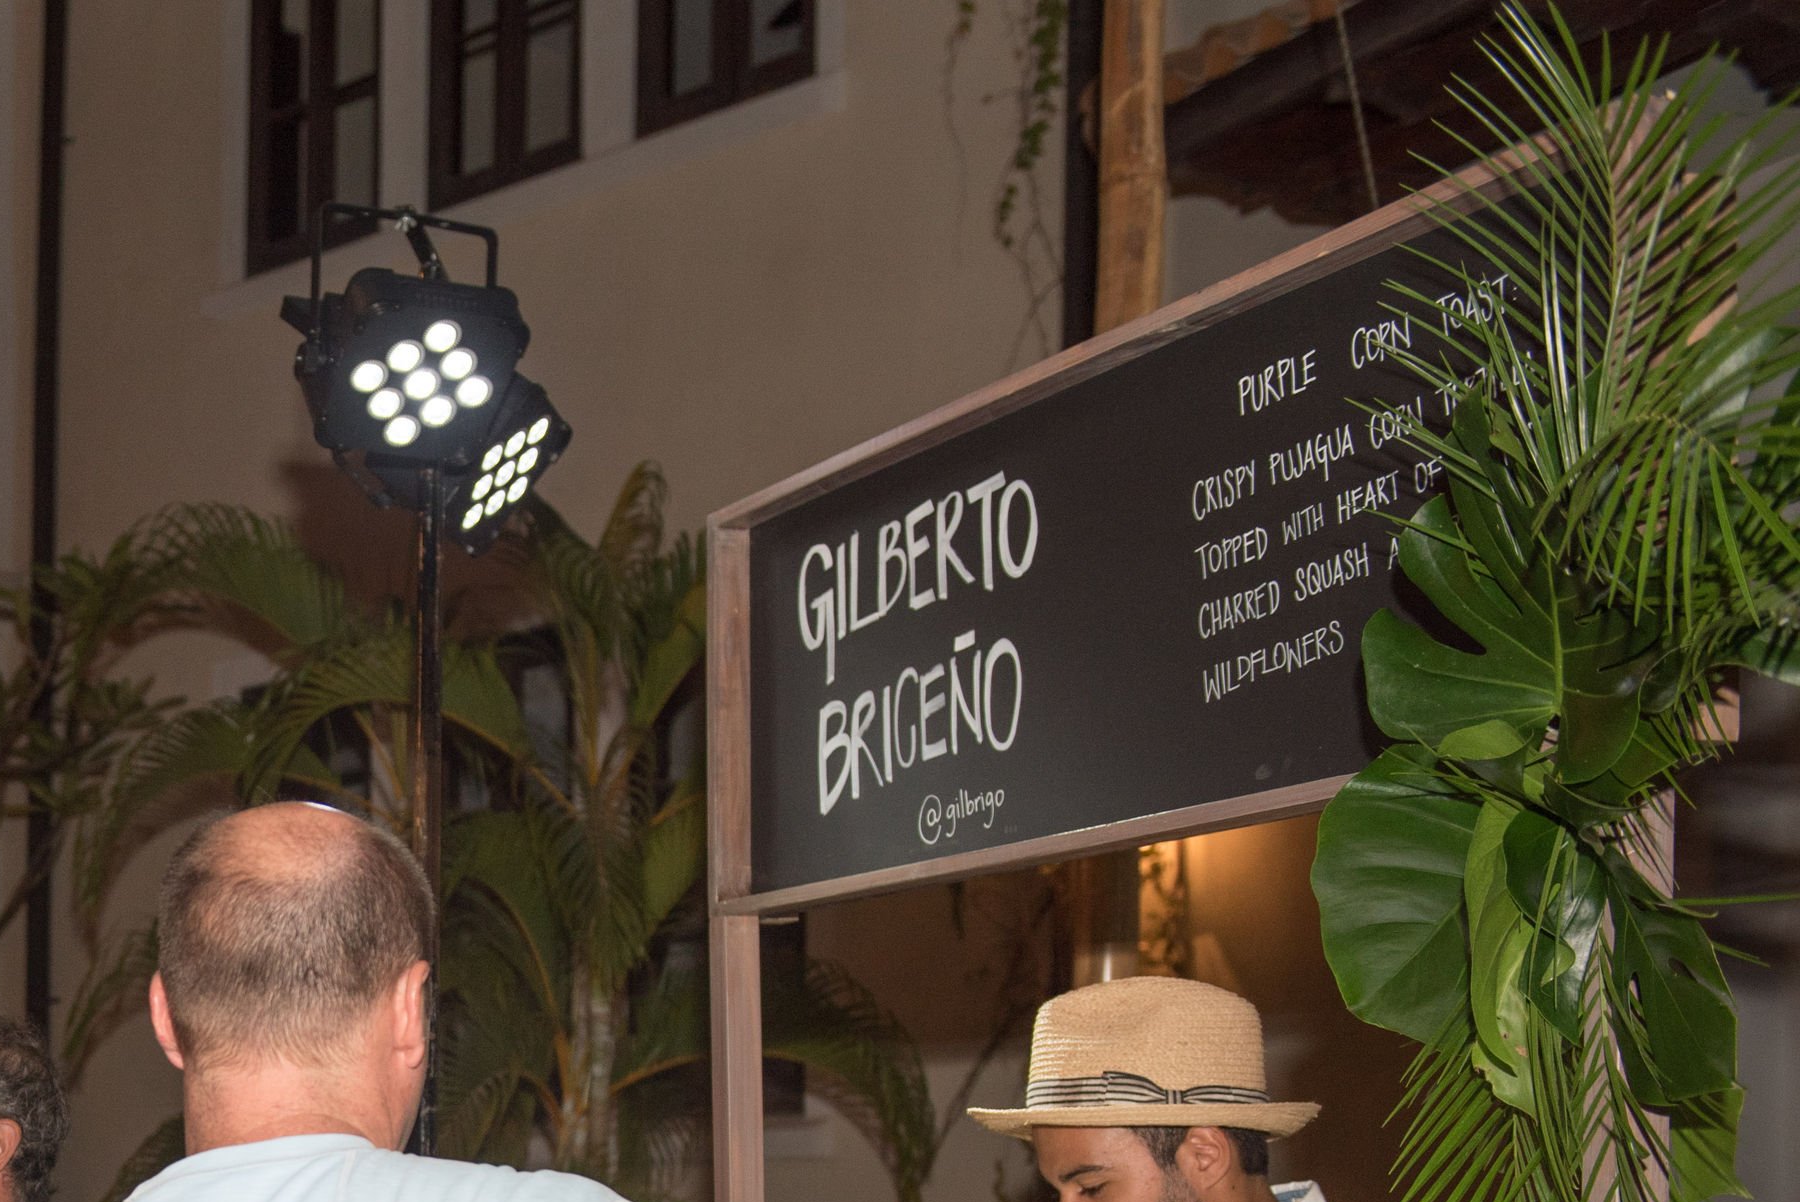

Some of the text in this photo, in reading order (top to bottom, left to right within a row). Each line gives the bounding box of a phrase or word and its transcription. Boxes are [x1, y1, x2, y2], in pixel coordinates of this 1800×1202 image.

[1238, 349, 1317, 416] PURPLE
[1351, 312, 1412, 369] CORN
[1192, 459, 1255, 522] CRISPY
[1269, 423, 1355, 483] PUJAGUA
[1369, 396, 1423, 450] CORN
[1194, 455, 1443, 580] TOPPED WITH HEART OF
[798, 471, 1039, 686] GILBERTO
[1198, 580, 1281, 640] CHARRED
[1294, 542, 1369, 602] SQUASH
[1202, 620, 1344, 703] WILDFLOWERS
[819, 629, 1022, 816] BRICEÑO
[918, 788, 1005, 845] @gilbrigo
